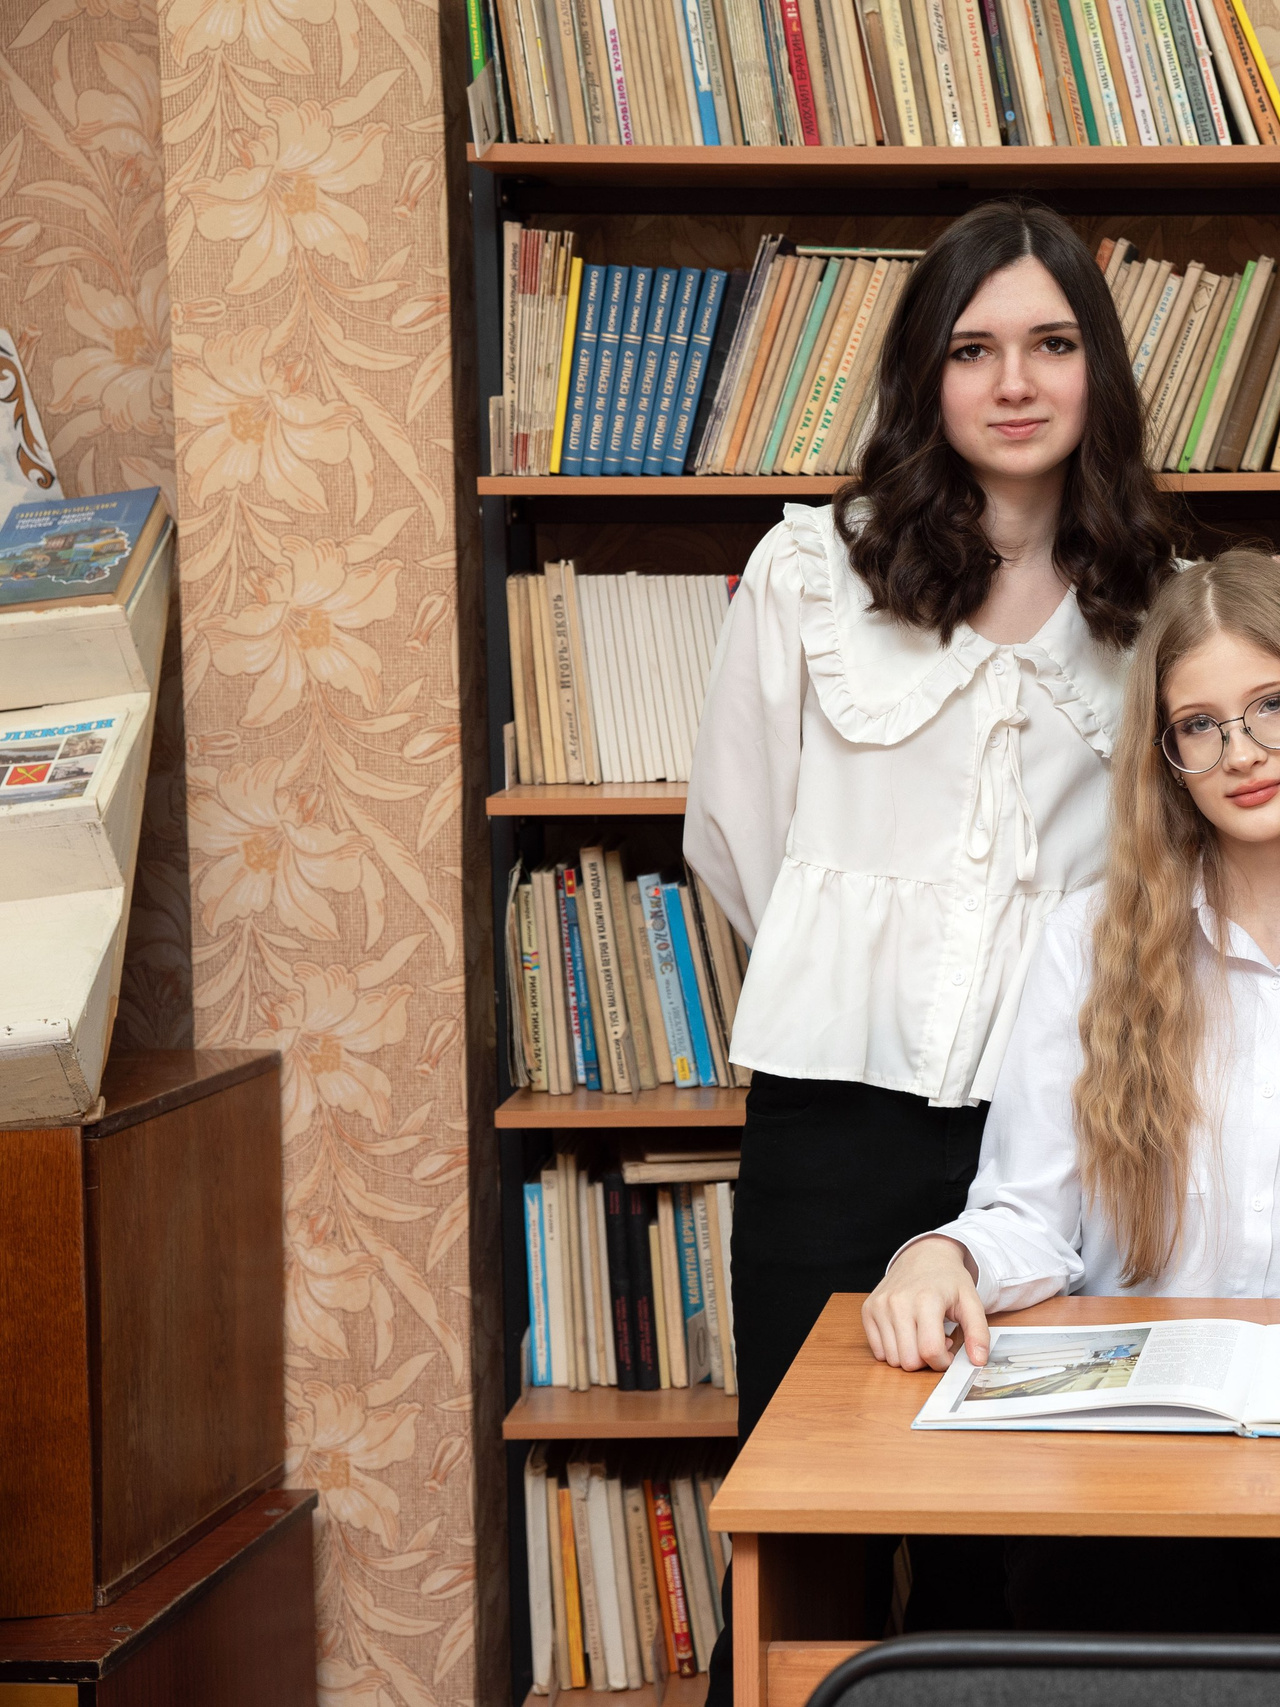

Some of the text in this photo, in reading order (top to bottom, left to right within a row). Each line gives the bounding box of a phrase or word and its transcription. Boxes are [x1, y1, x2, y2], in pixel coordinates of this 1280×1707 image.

[472, 30, 480, 60] Татьяна
[966, 7, 981, 57] КРАСНОЕ
[1085, 2, 1096, 30] ОДИН
[1154, 3, 1166, 30] ОДИН
[792, 35, 816, 136] МИХАИЛ БРАГИН
[944, 64, 954, 97] БАРТО
[1094, 40, 1110, 91] МИЛЛИОН
[1164, 40, 1182, 91] МИЛЛИОН
[1246, 67, 1260, 94] ГОРЕ
[899, 58, 915, 135] АГНИЯ БАРТО
[1140, 109, 1151, 134] ВОЛКОВ
[1189, 75, 1212, 142] СЕРГЕЙ ВОРОНИН
[1258, 96, 1267, 112] НА
[585, 271, 599, 330] БОРИС ГАНАГО
[607, 272, 622, 332] БОРИС ГАНАГО
[630, 273, 646, 332] БОРИС ГАНАГО
[653, 273, 670, 332] БОРИС ГАНАГО
[676, 274, 694, 333] БОРИС ГАНАГО
[700, 275, 719, 333] БОРИС ГАНАГО
[1149, 286, 1174, 337] ОВСЕЙ ДРИЗ
[819, 269, 883, 431] ВИКТОР ГОЛЯВКИН ОДИН, ДВА,
[1168, 319, 1195, 382] ДРАГУНСКИЙ
[569, 349, 590, 450] ГОТОВО ЛИ СЕРДЦЕ?
[589, 350, 612, 451] ГОТОВО ЛИ СЕРДЦЕ?
[610, 351, 634, 451] ГОТОВО ЛИ СЕРДЦЕ?
[631, 351, 657, 451] ГОТОВО ЛИ СЕРДЦЕ?
[652, 351, 680, 450] ГОТОВО ЛИ СЕРДЦЕ?
[673, 351, 703, 450] ГОТОВО ЛИ СЕРДЦЕ?
[799, 408, 815, 431] ДВА,
[553, 594, 571, 690] ИГОРЬ-ЯКОРЬ
[0, 717, 116, 742] ЛЕКСИН
[594, 901, 607, 933] КАПИТАН
[601, 941, 612, 967] ПЕТРОВ
[605, 967, 617, 1008] МАЛЕНЬКИЙ
[529, 975, 543, 1073] РИККИ-ТИККИ-ТАВИ
[682, 1247, 701, 1305] КАПИТАН
